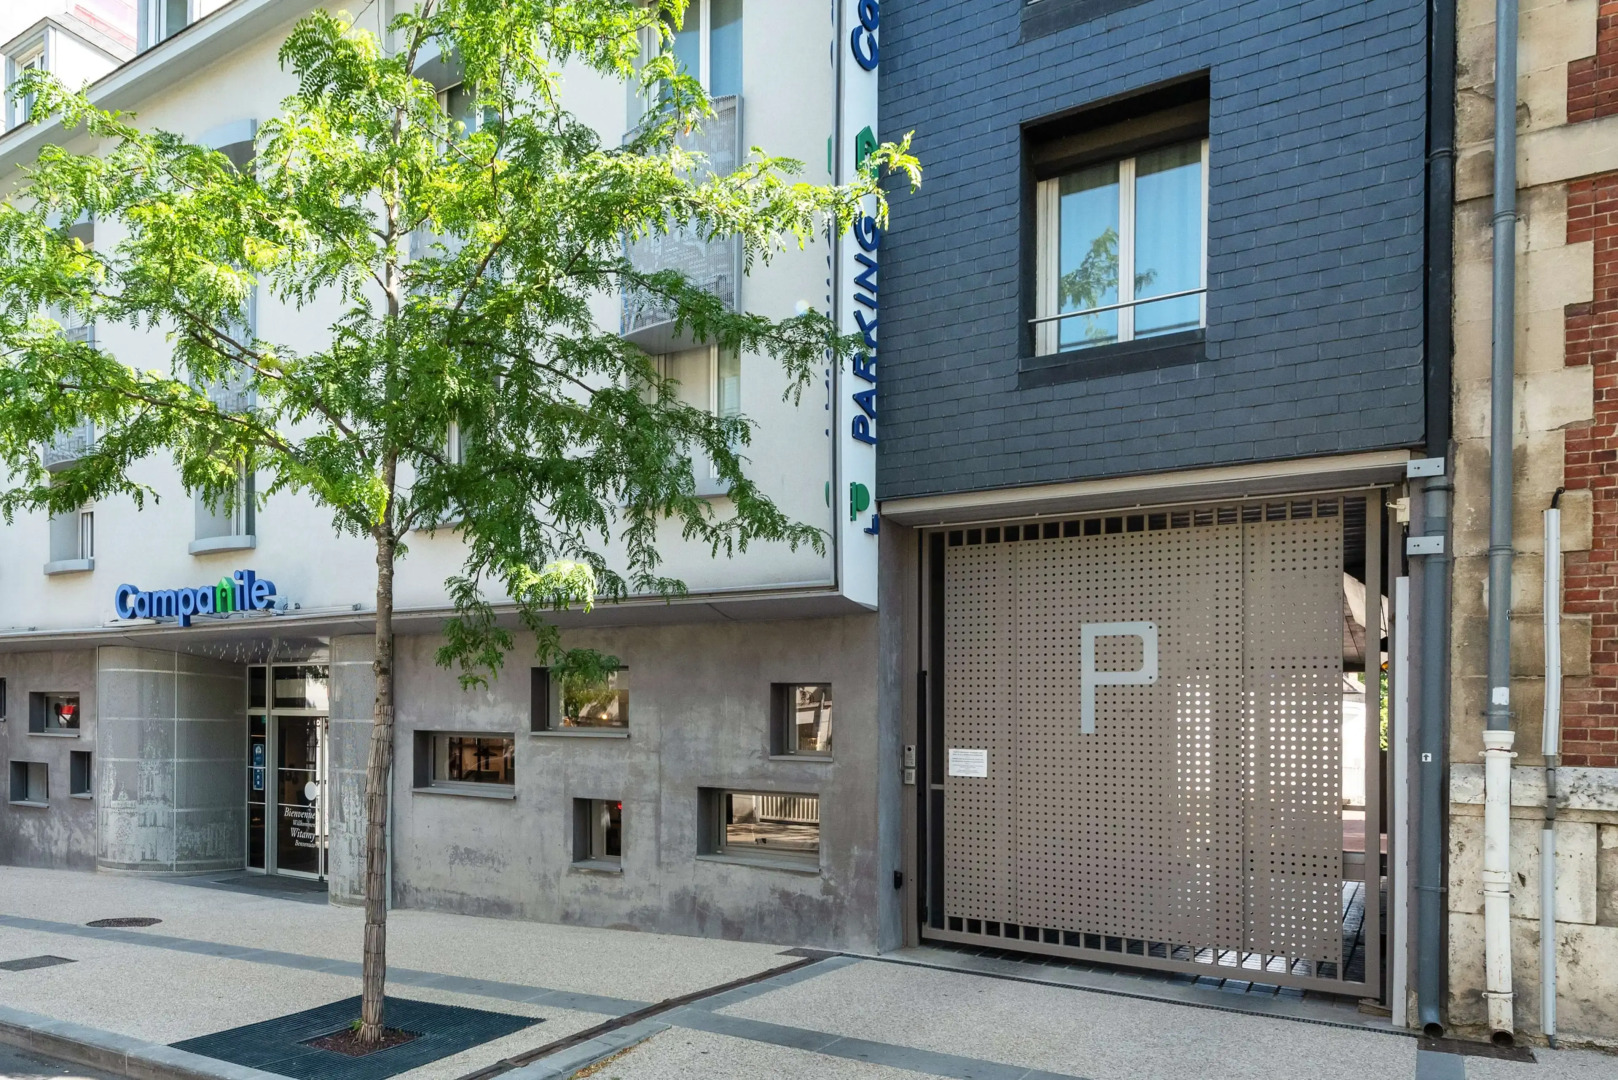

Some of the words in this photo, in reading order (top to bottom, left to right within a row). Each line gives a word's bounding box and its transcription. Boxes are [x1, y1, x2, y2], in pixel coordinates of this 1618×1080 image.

[852, 211, 879, 445] PARKING
[115, 569, 277, 627] Campanile
[1081, 621, 1158, 734] P
[290, 827, 316, 842] Witamy
